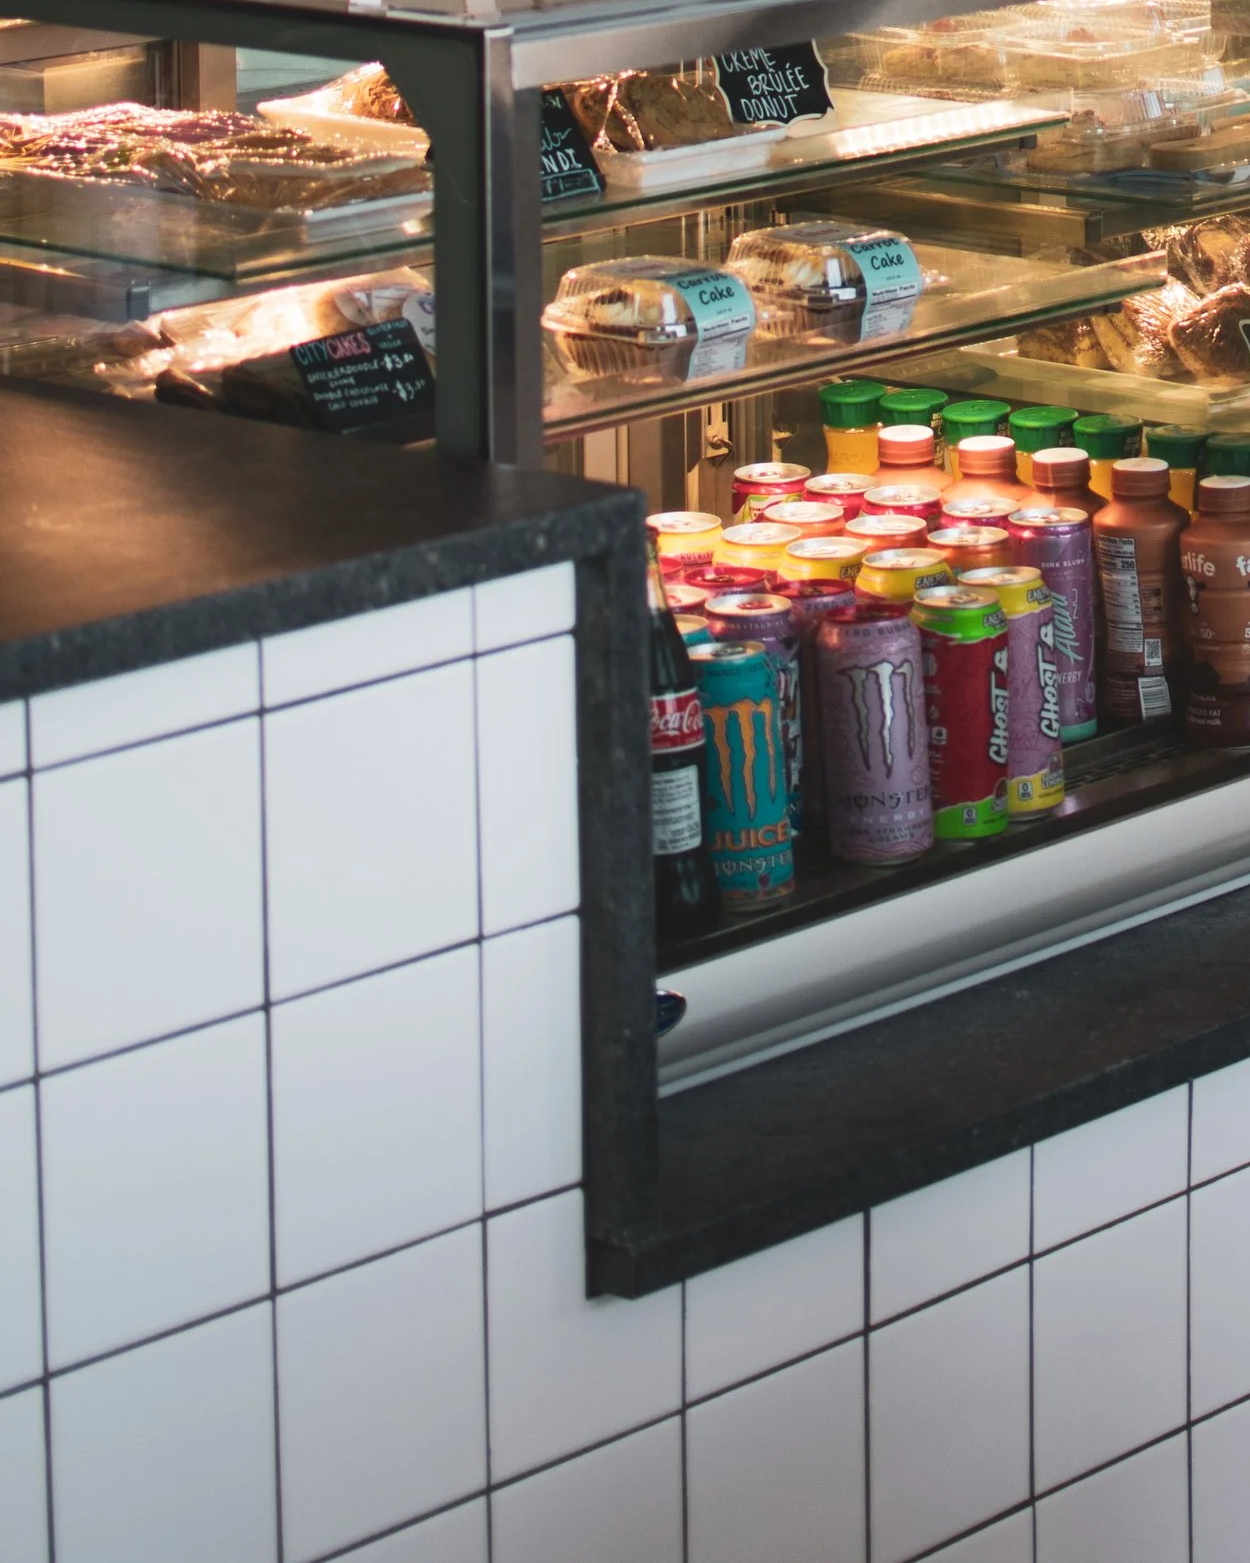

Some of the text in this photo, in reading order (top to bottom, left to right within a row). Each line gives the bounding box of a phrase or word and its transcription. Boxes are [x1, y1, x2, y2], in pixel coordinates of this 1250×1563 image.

[746, 61, 810, 96] BRÛLÉE
[740, 94, 801, 122] DONUT
[850, 237, 900, 254] Carrot
[870, 252, 905, 270] Cake
[677, 272, 728, 290] Carrot
[698, 285, 736, 306] Cake
[295, 331, 372, 366] CITY CAKES
[840, 564, 861, 579] ENE
[1121, 560, 1135, 569] 250
[1181, 552, 1216, 577] rlife
[1057, 669, 1082, 686] NERGY
[709, 821, 788, 852] JUICE
